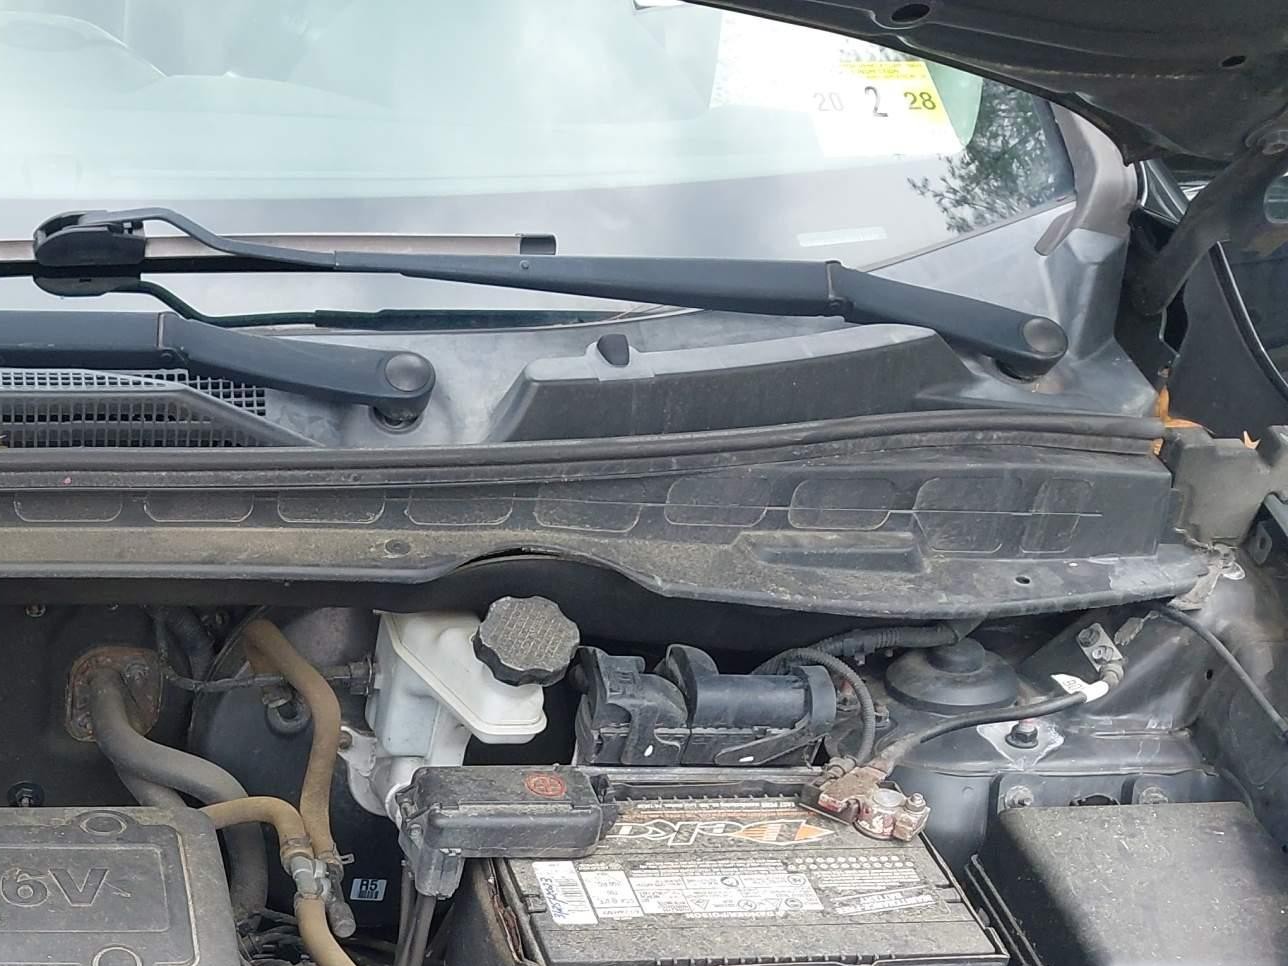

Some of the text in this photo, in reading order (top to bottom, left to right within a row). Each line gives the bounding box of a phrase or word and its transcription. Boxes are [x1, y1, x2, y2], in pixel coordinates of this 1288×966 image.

[813, 86, 937, 117] 20 2 28
